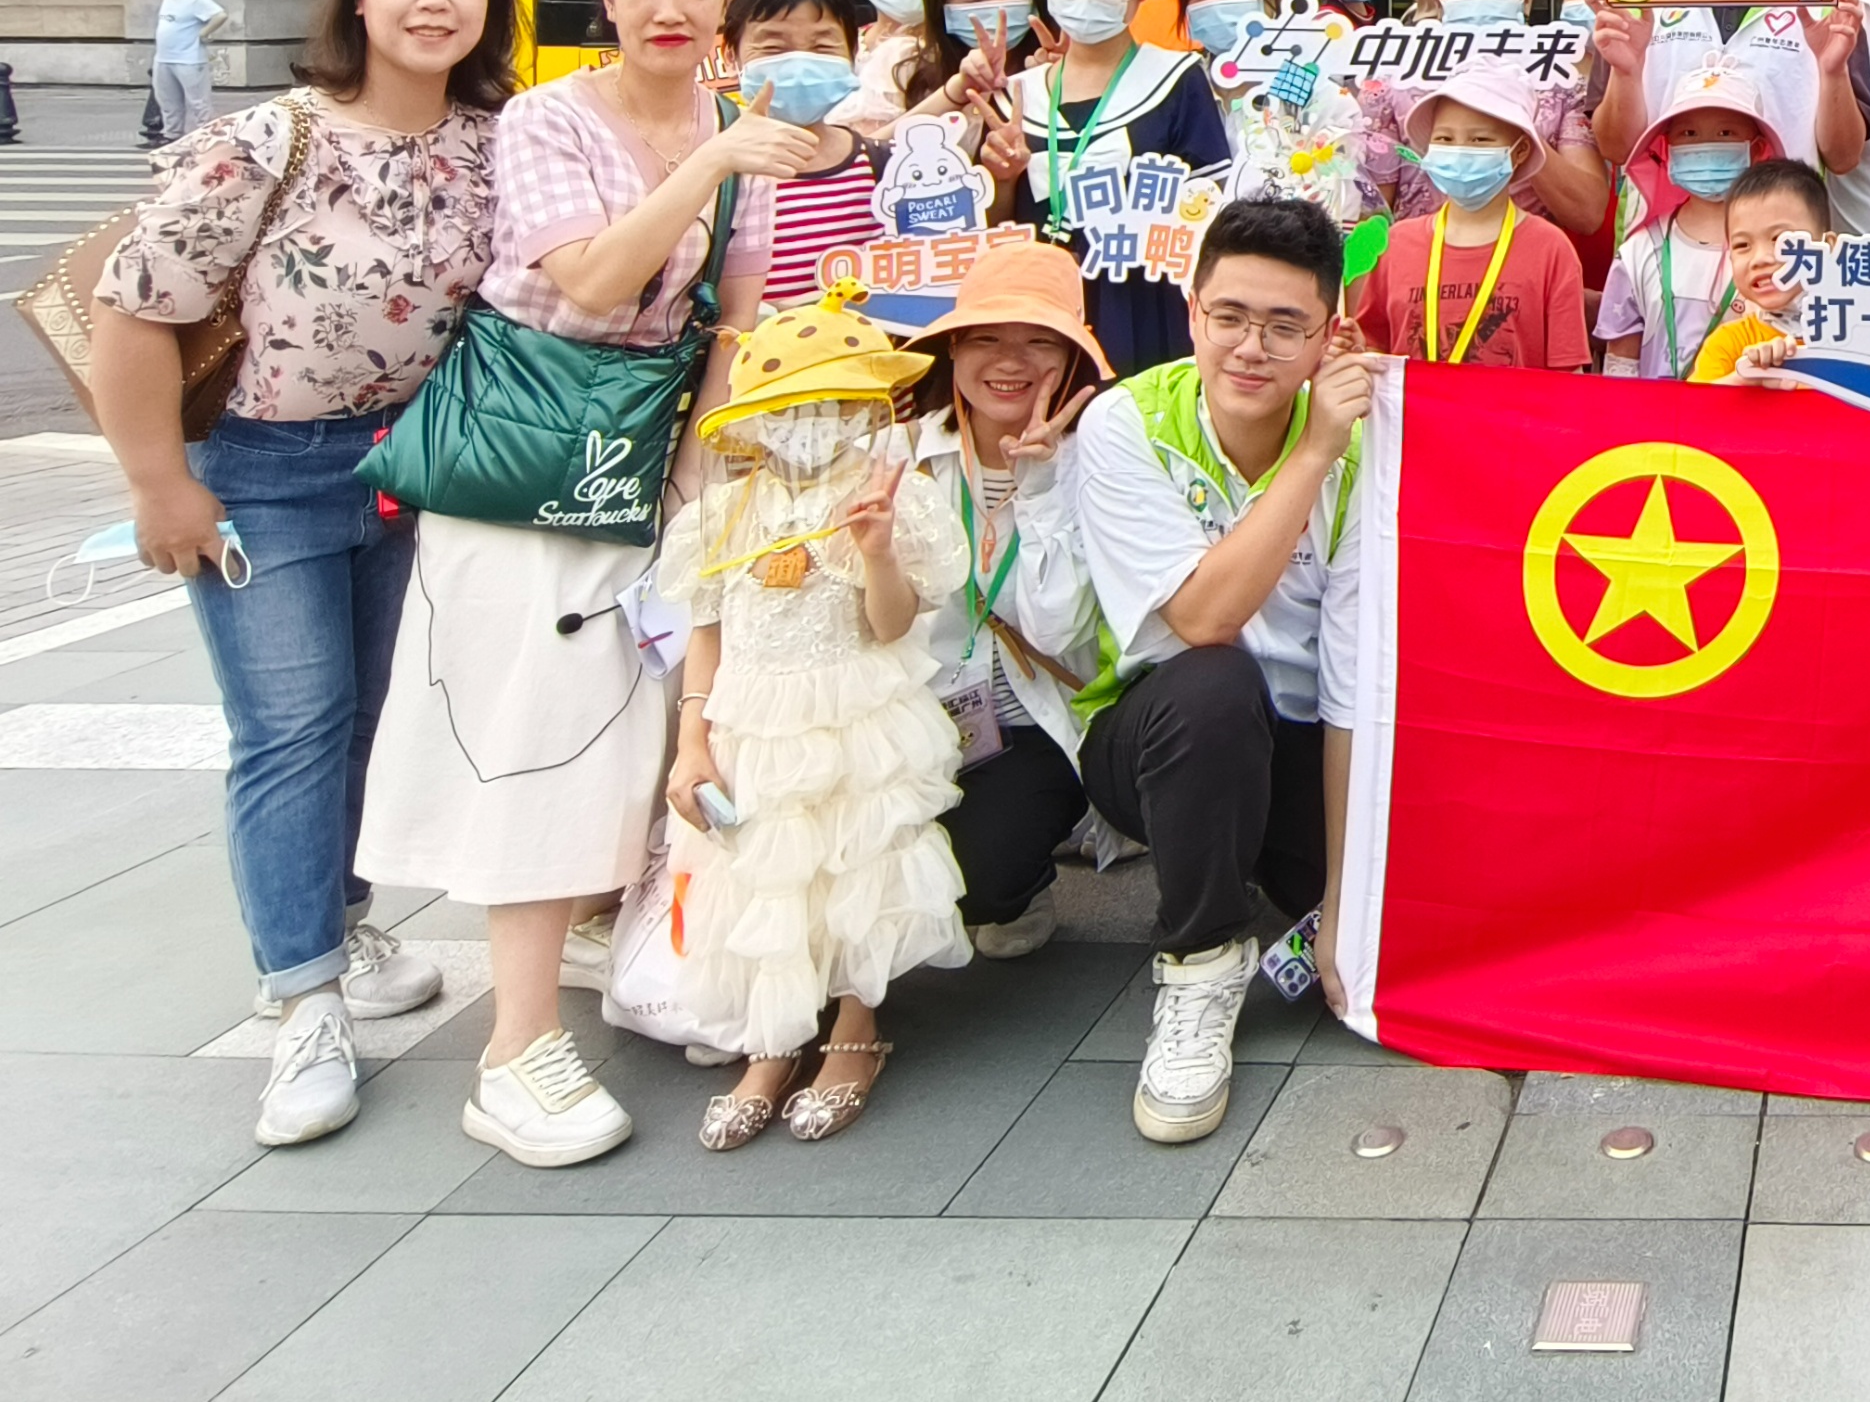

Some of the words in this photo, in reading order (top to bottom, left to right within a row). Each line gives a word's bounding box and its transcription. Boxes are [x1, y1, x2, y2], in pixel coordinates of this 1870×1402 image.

[1070, 158, 1185, 222] 向前
[908, 206, 955, 224] SWEAT
[1085, 223, 1195, 279] 冲鸭
[533, 499, 652, 527] Starbucks
